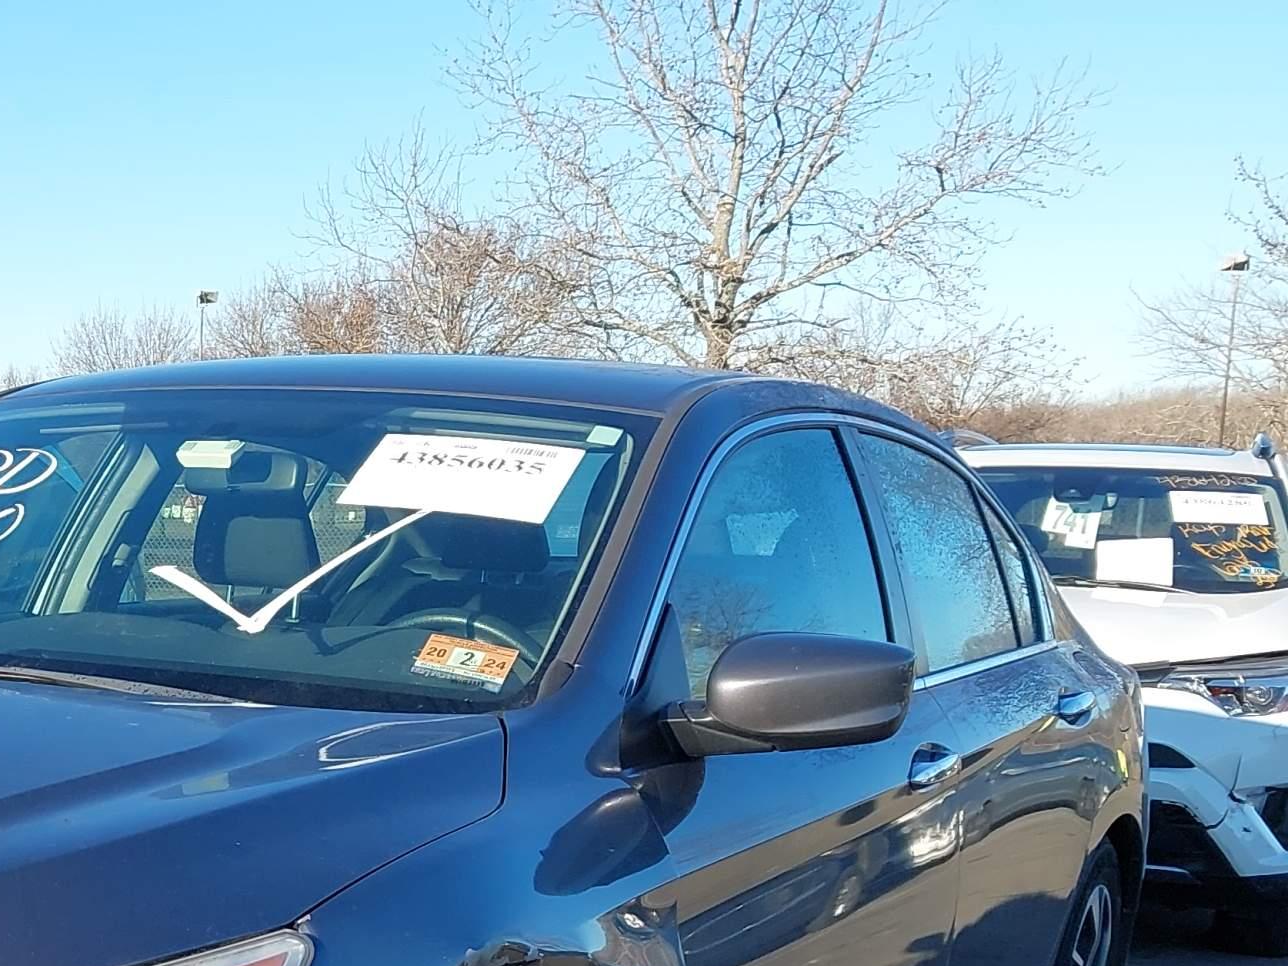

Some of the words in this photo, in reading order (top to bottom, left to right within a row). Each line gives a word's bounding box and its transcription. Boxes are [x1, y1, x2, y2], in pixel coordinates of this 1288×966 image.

[389, 450, 547, 475] 43856035
[426, 646, 448, 658] 20
[460, 651, 476, 666] 2
[484, 658, 507, 671] 24
